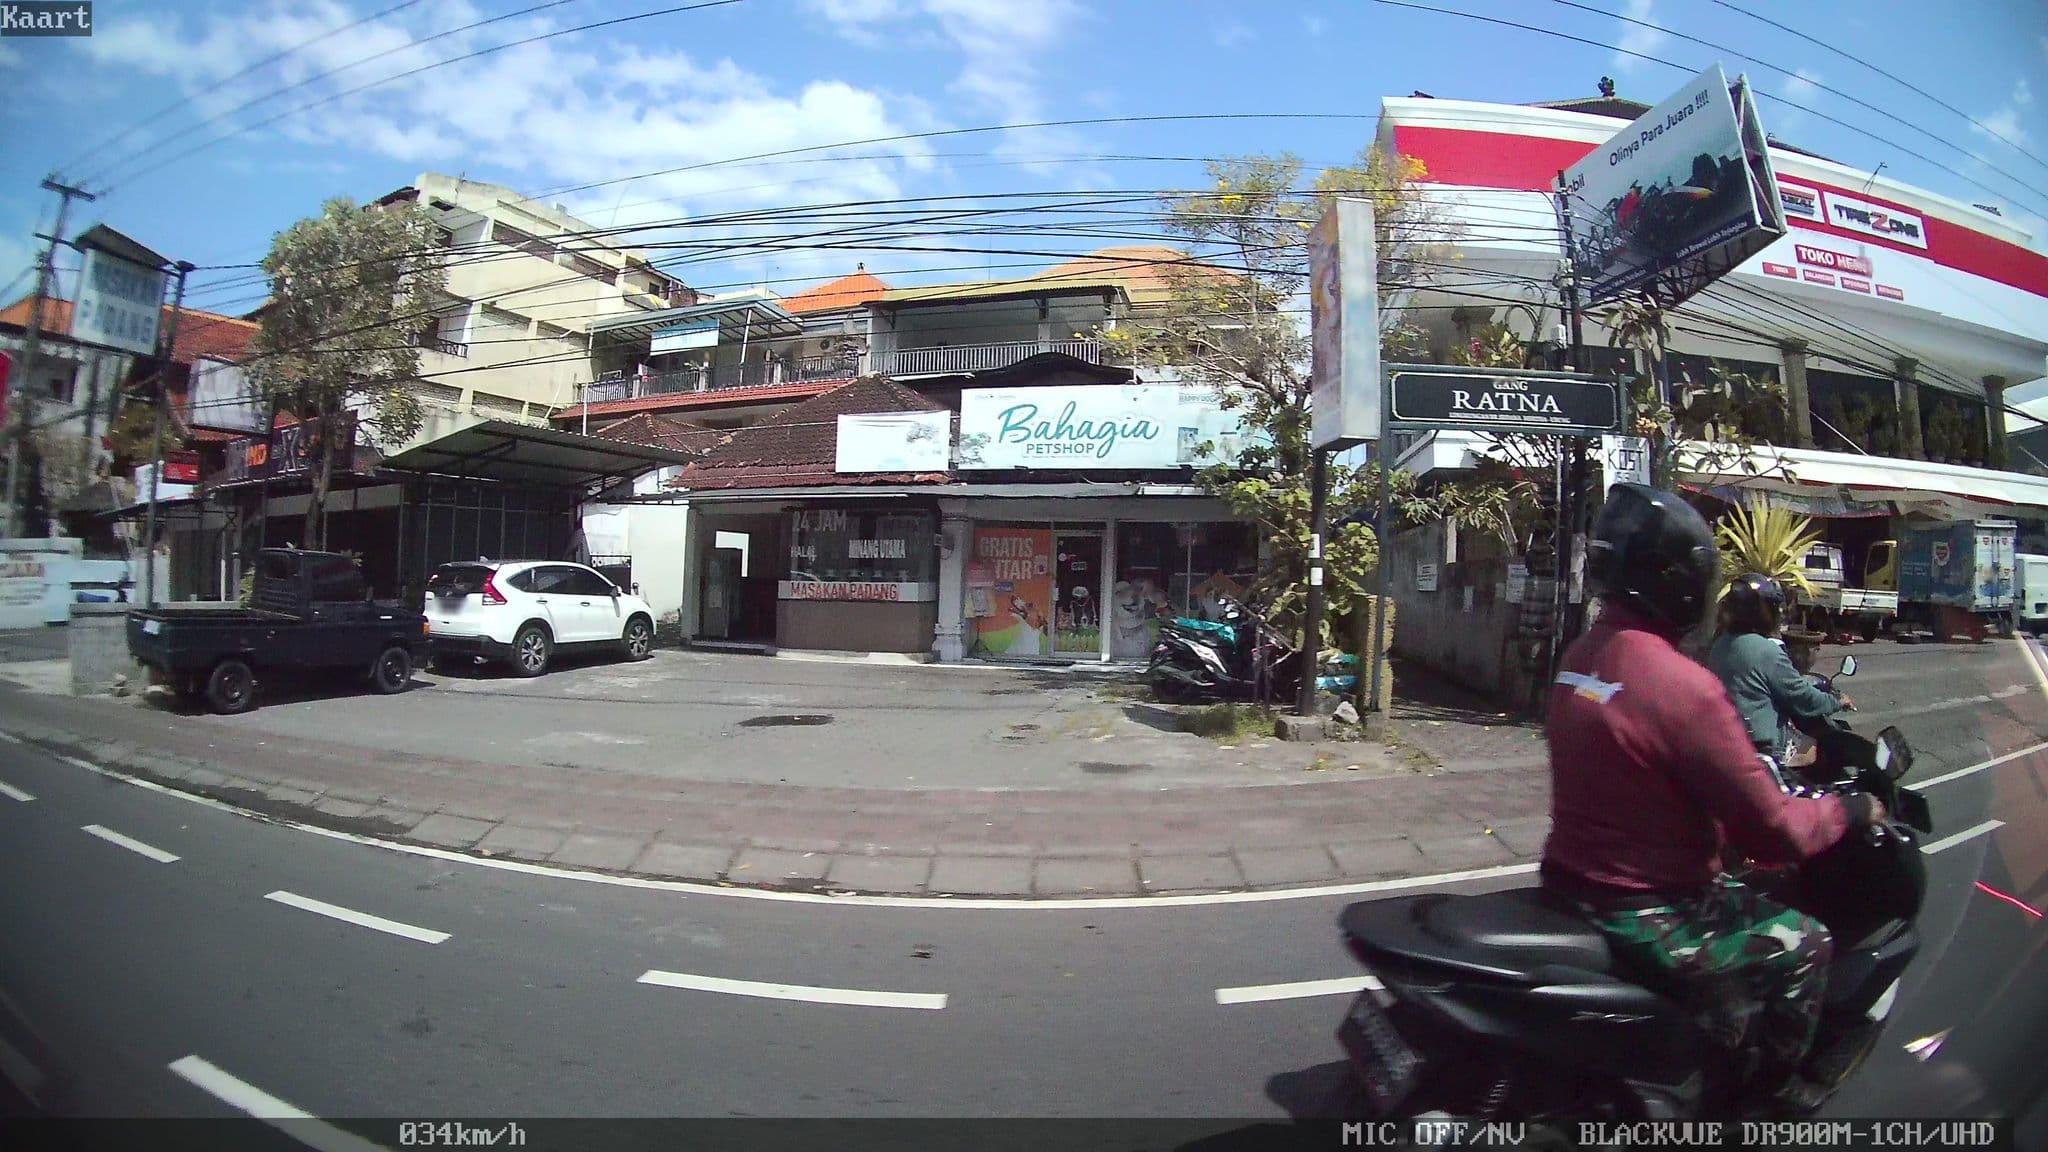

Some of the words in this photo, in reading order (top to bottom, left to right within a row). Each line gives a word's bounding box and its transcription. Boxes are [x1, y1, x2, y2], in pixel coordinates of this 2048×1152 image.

[1609, 139, 1640, 167] Olinya
[1640, 124, 1664, 146] Para
[1665, 103, 1694, 130] Juara
[1796, 246, 1834, 265] TOKO
[1493, 380, 1529, 391] GANG
[1452, 390, 1561, 413] RATNA
[998, 400, 1159, 458] Bahagia
[1026, 443, 1095, 455] PETSHOP
[1607, 448, 1644, 472] KOST
[814, 509, 848, 532] JAM
[979, 537, 1034, 557] GRATIS
[790, 583, 847, 600] MASAKAN
[850, 584, 897, 600] PADANG
